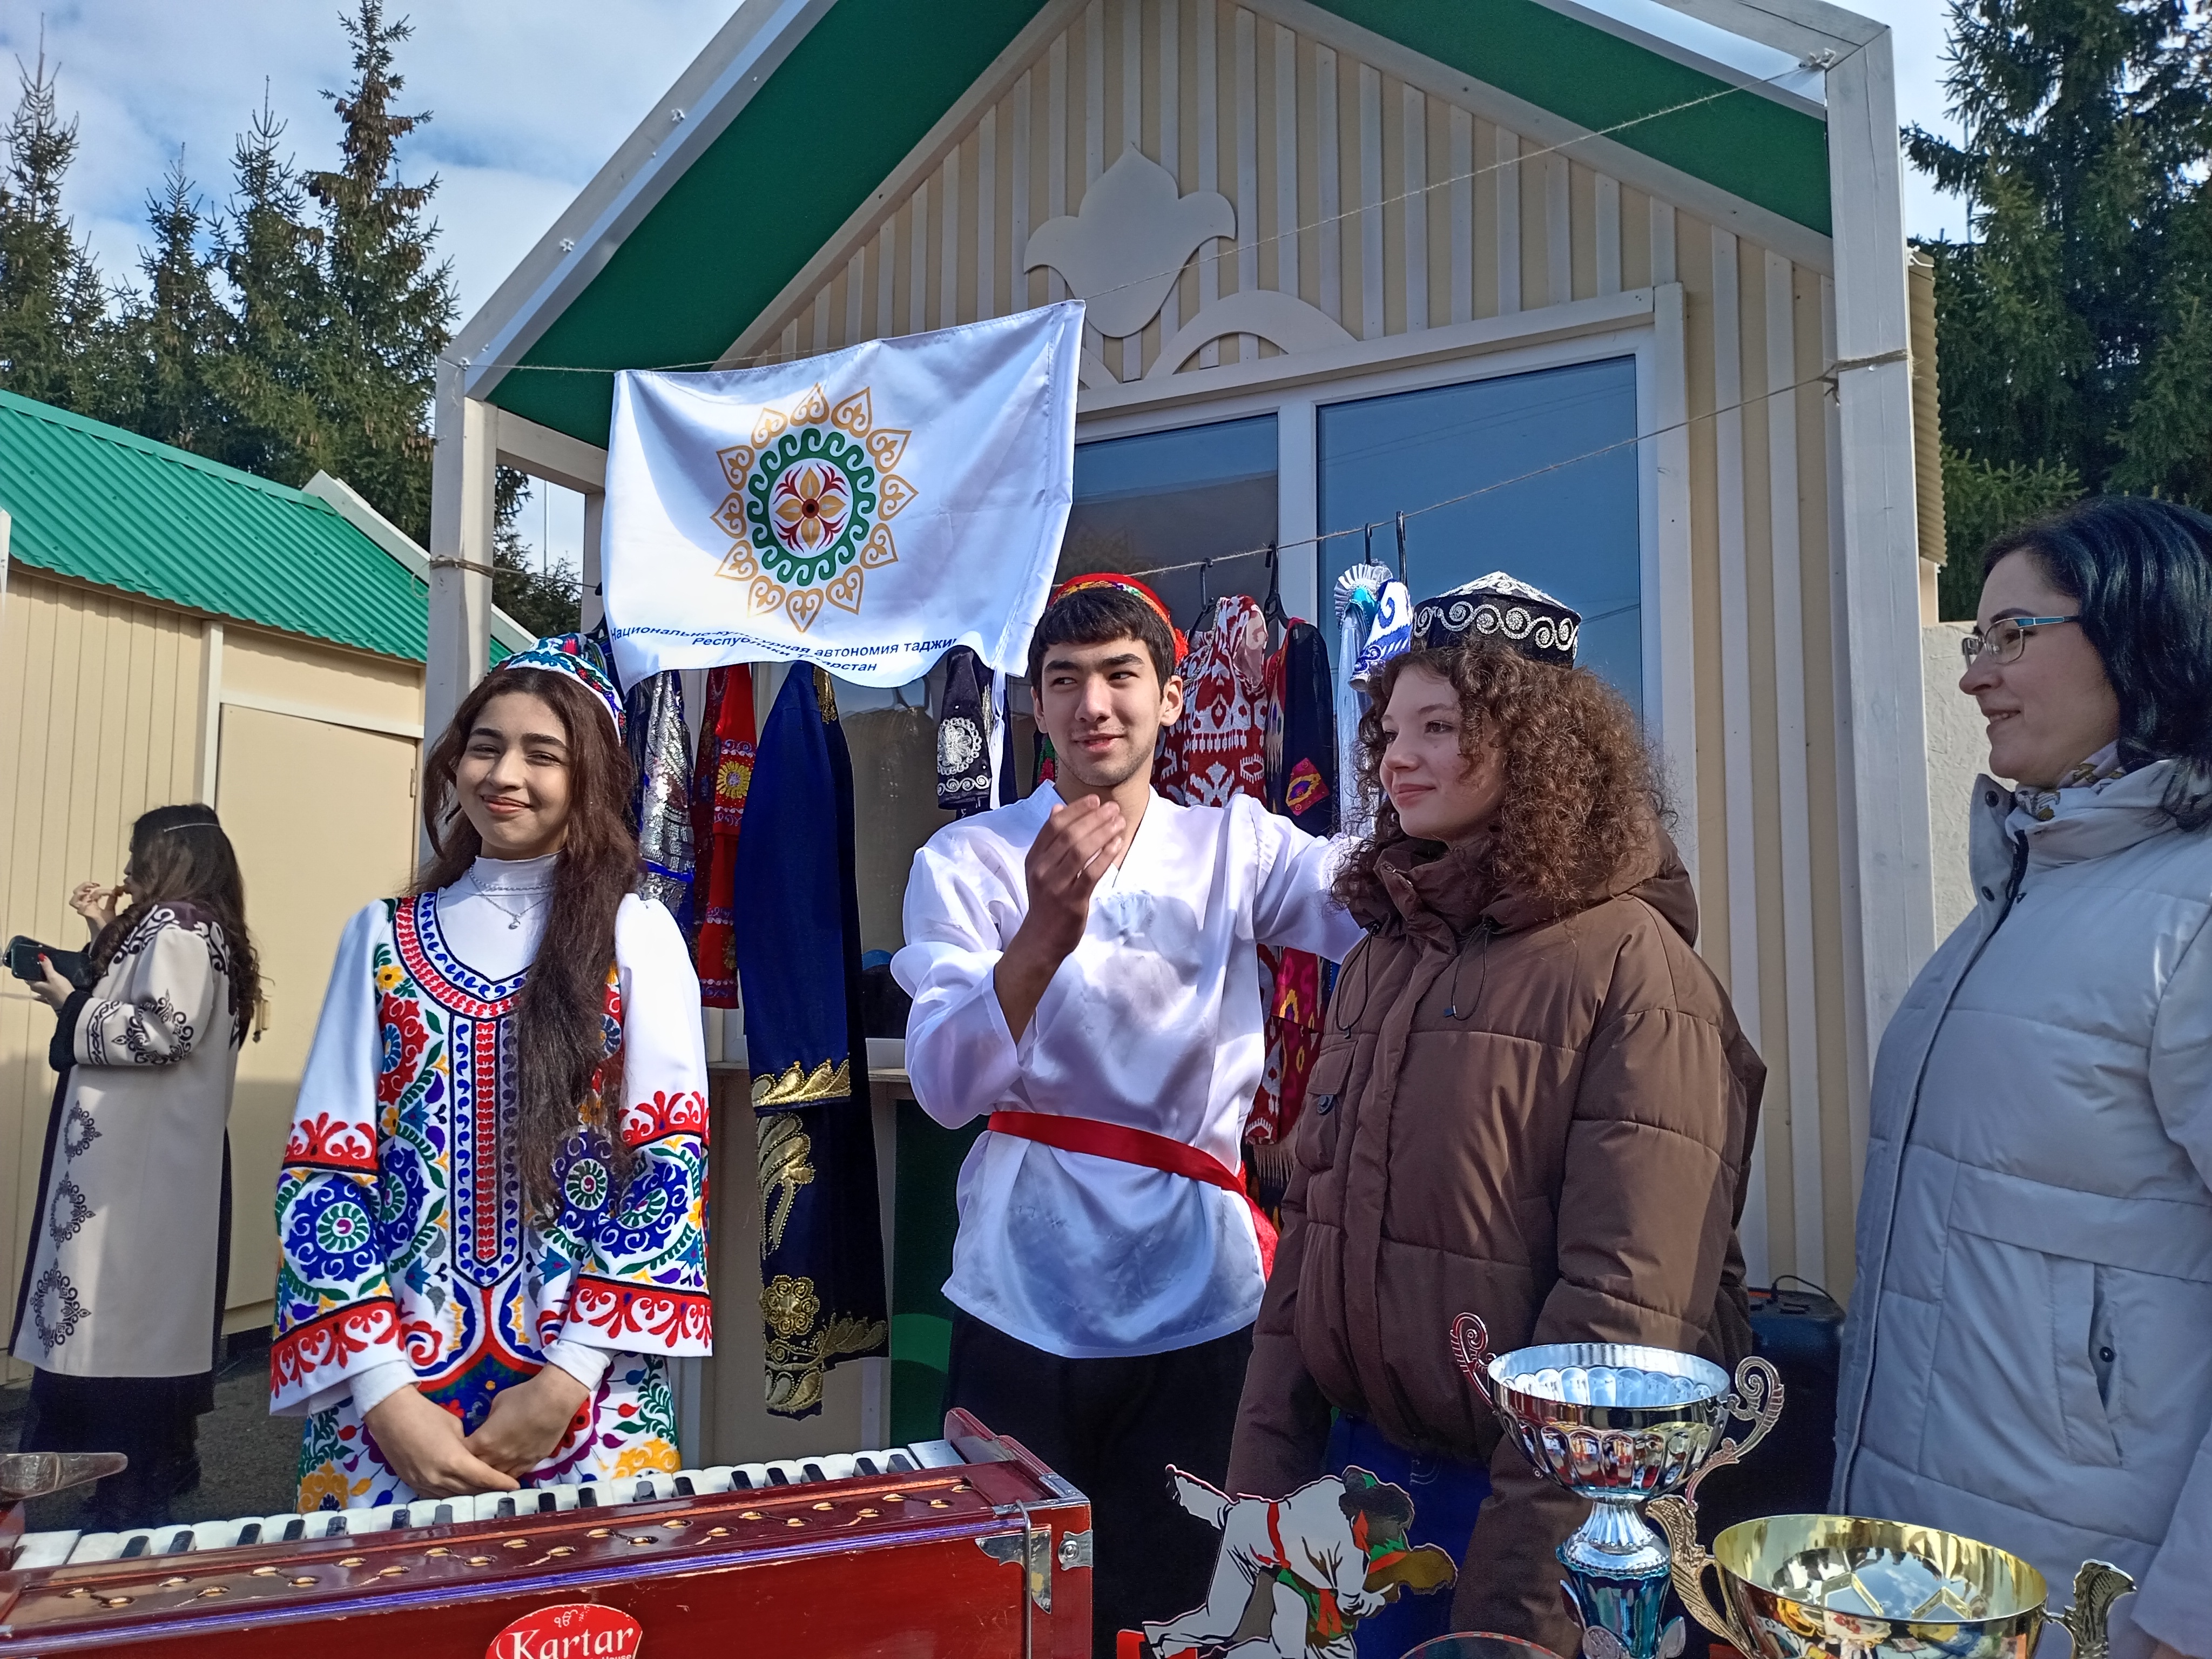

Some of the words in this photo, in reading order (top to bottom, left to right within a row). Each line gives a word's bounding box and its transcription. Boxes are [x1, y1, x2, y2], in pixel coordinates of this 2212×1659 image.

[611, 627, 811, 653] Национально-куурная
[814, 644, 899, 657] автономия
[692, 637, 791, 656] Республики
[496, 1628, 633, 1659] Kartar
